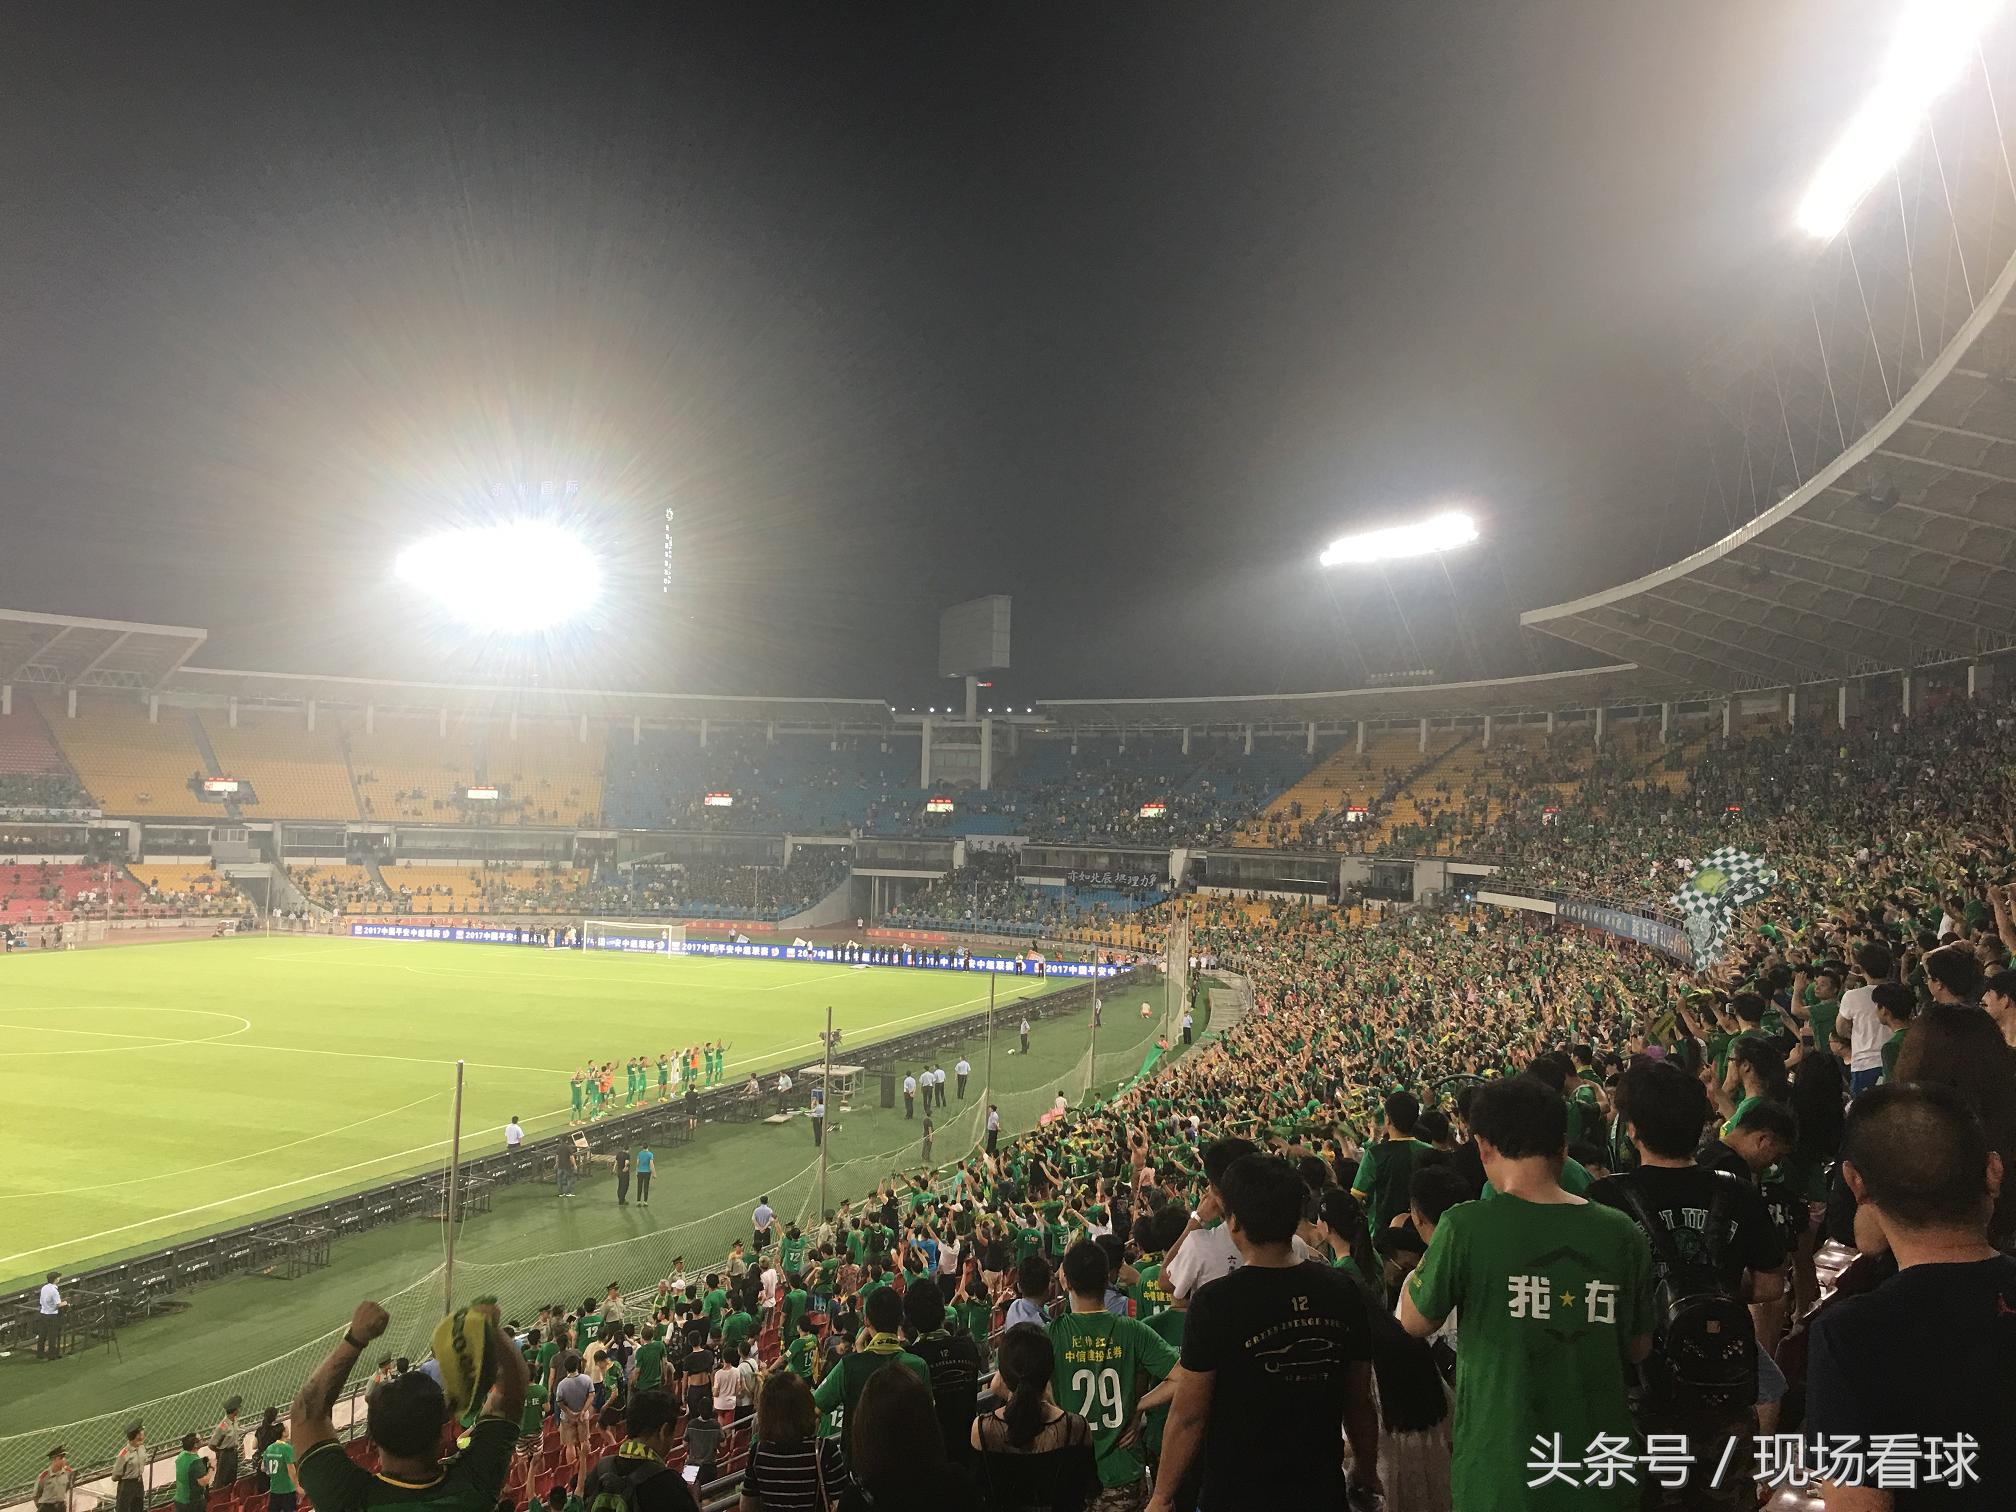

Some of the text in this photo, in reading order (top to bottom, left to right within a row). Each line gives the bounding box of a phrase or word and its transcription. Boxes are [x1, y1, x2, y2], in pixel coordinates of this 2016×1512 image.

[681, 942, 769, 957] 2017中国平安中超联赛
[1291, 1295, 1310, 1312] 12
[1508, 1275, 1551, 1320] 我
[585, 1326, 600, 1339] 12
[1072, 1367, 1124, 1431] 29
